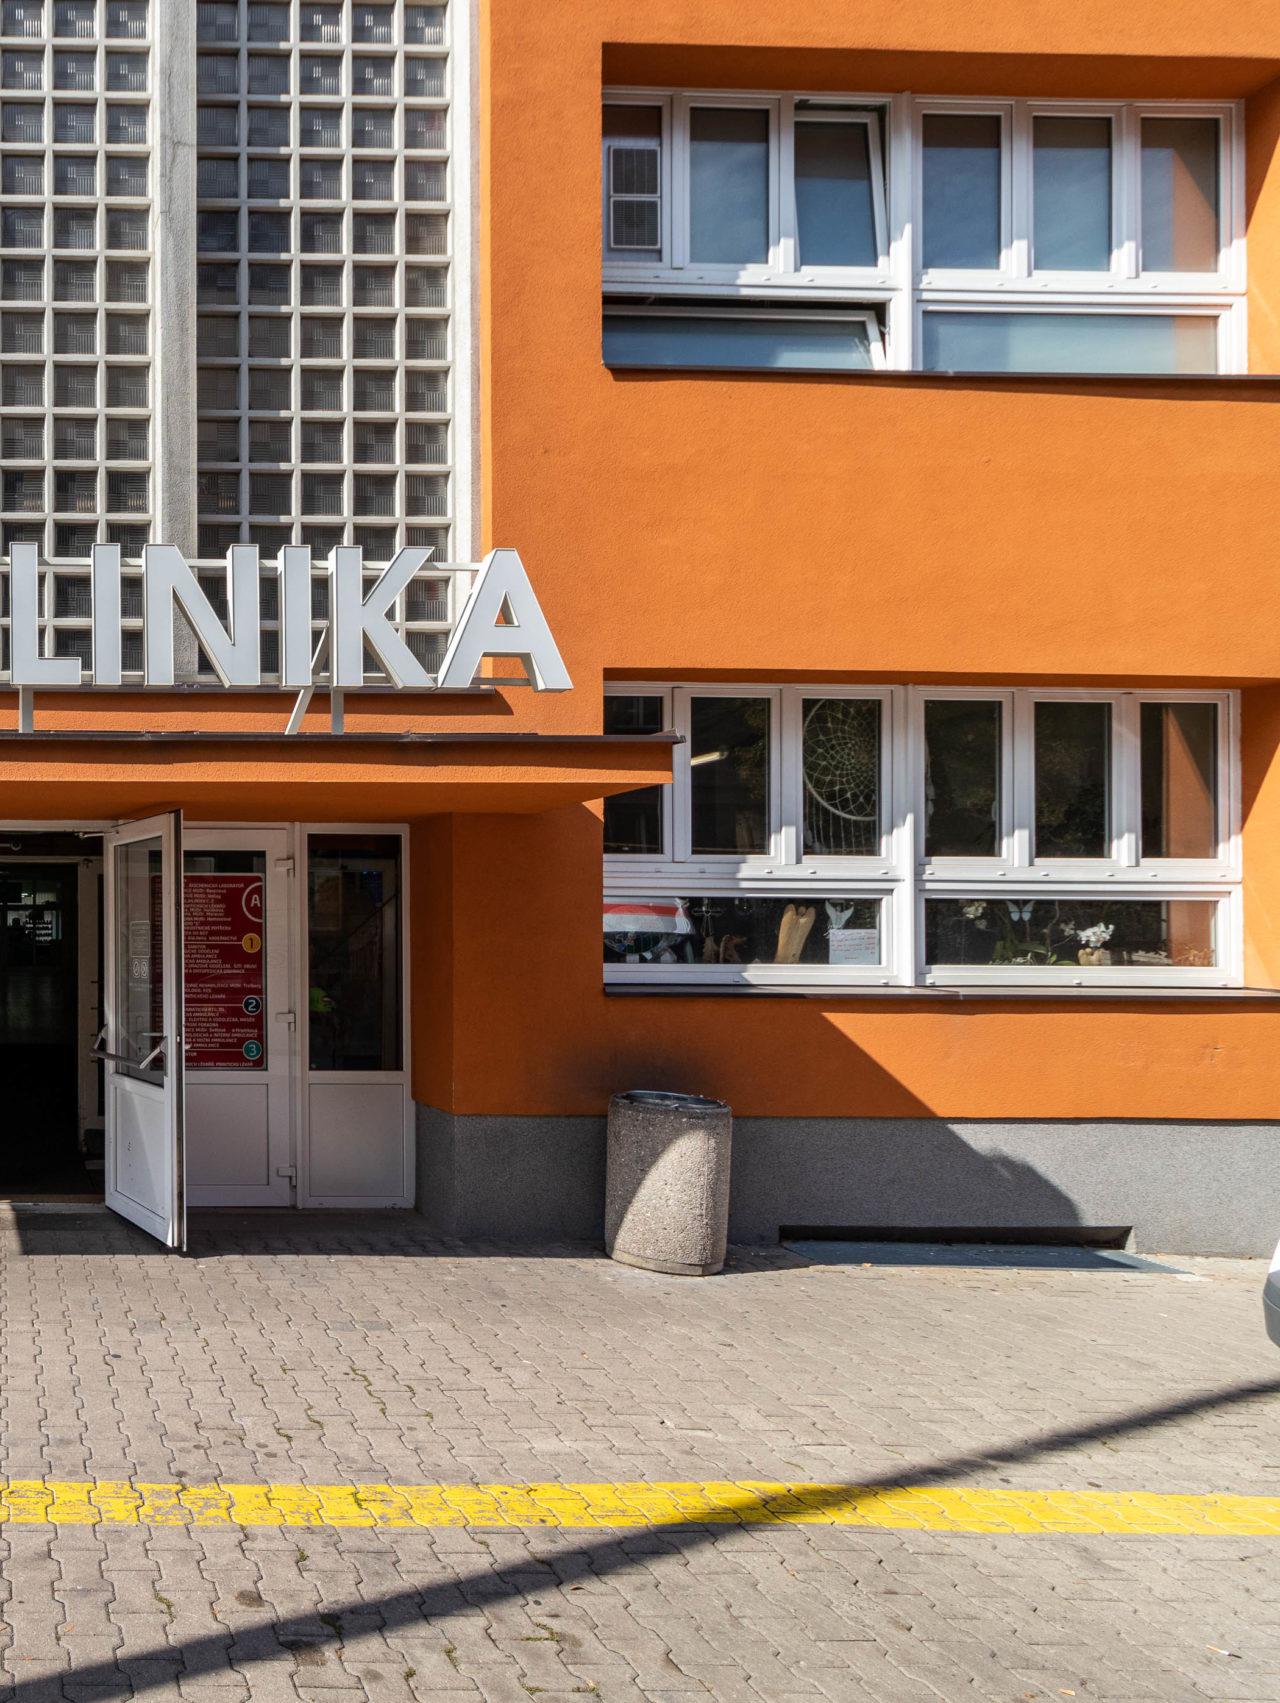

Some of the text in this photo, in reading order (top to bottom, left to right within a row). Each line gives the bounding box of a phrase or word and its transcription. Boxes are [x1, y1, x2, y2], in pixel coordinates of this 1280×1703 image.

[250, 894, 261, 908] A
[248, 999, 256, 1011] 2
[249, 1044, 257, 1056] 3
